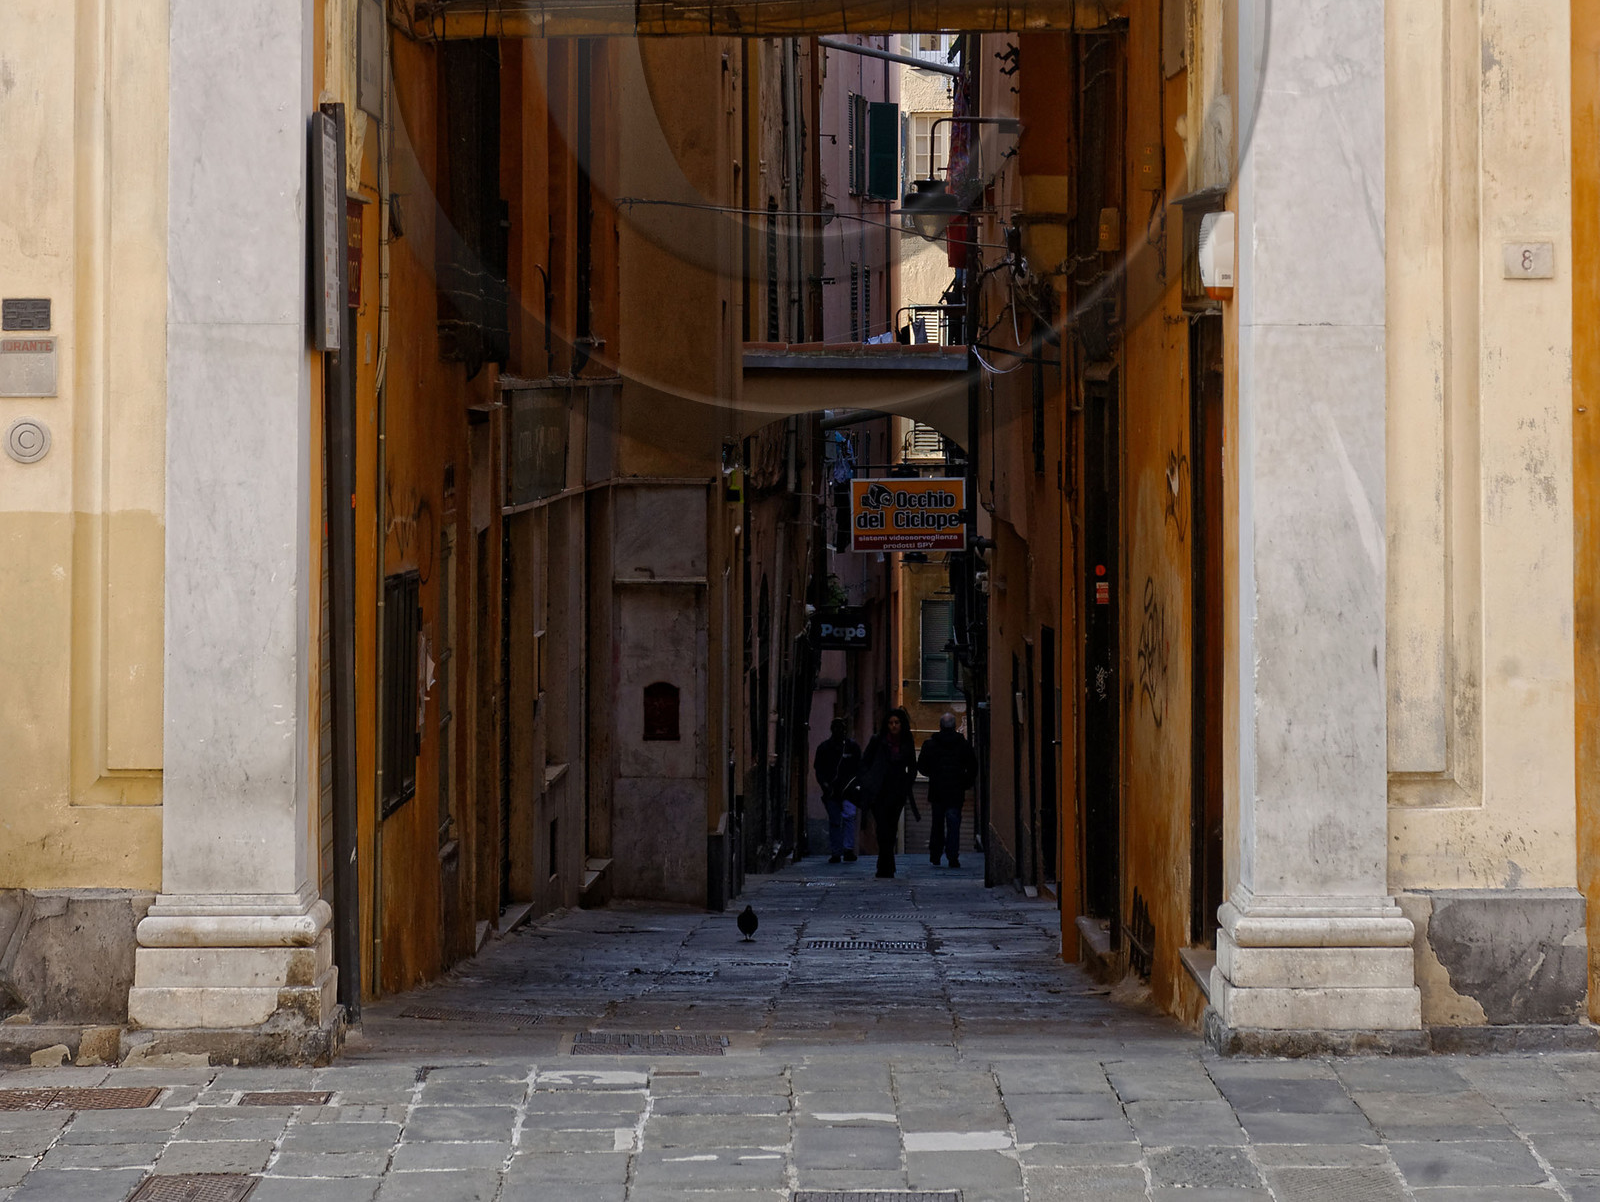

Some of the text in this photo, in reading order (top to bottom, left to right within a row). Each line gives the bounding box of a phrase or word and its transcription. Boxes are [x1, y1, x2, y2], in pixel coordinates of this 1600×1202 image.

[1521, 249, 1534, 271] 8
[2, 341, 53, 352] IDRANTE
[895, 490, 956, 509] Occhio
[856, 510, 960, 531] del Ciclope
[858, 534, 888, 542] sistemi
[883, 541, 934, 550] prodotti SPY
